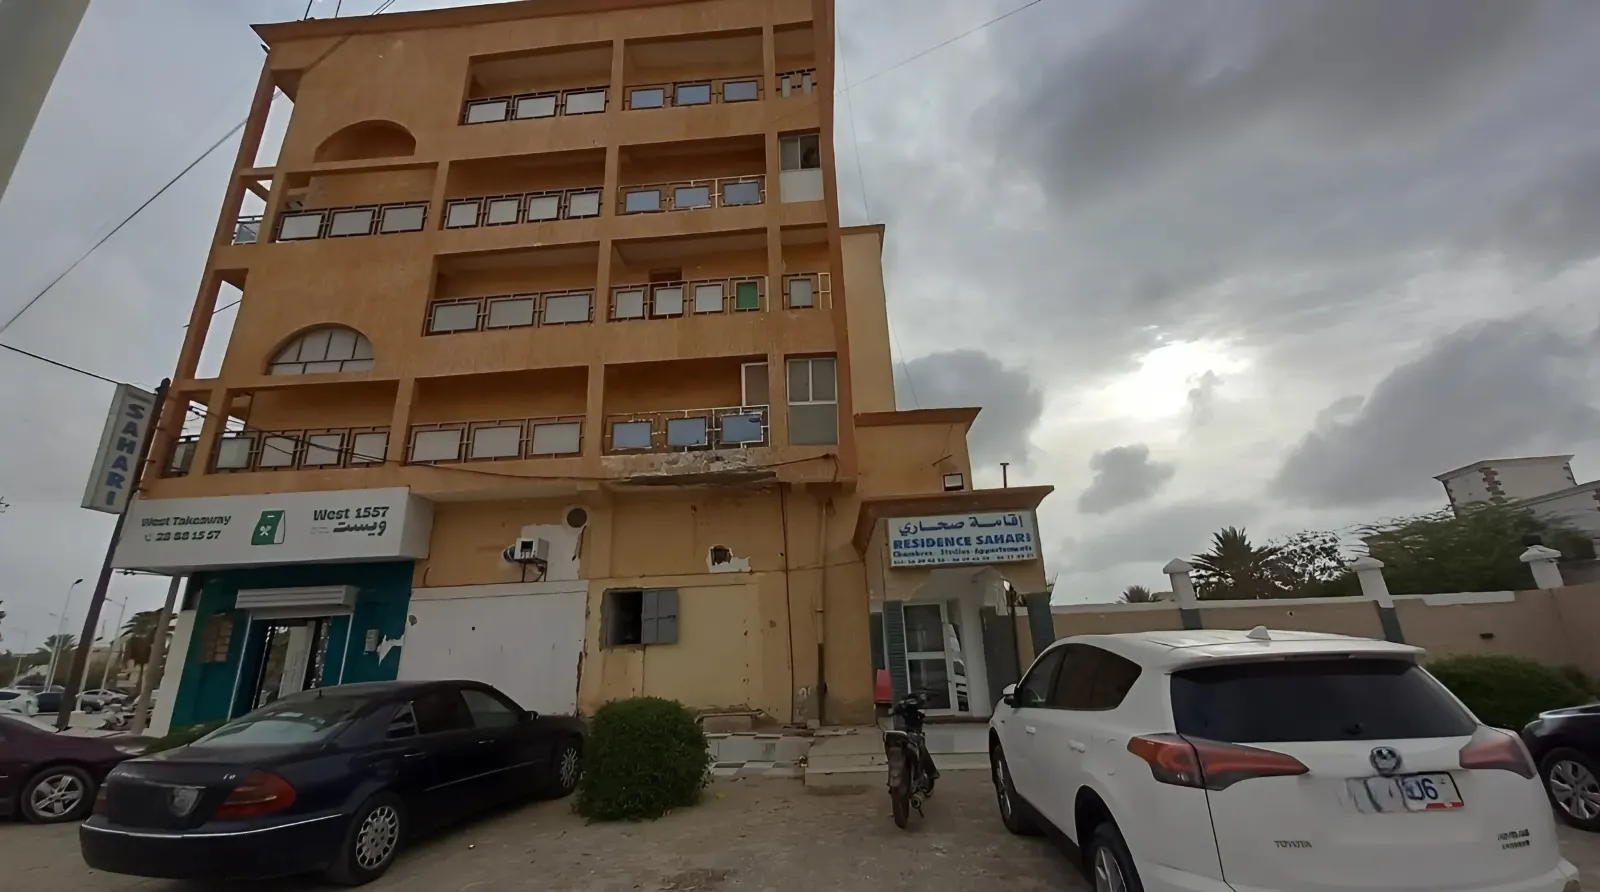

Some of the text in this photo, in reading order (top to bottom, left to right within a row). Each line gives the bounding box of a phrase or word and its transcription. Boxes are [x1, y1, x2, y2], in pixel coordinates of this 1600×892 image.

[105, 403, 145, 506] SAHARI
[173, 515, 232, 526] Takeaway
[313, 506, 390, 521] West 1557
[333, 520, 387, 537] ويست
[899, 513, 1024, 537] إقامة صحاري
[893, 533, 1031, 550] RESIDENCE SAHARI
